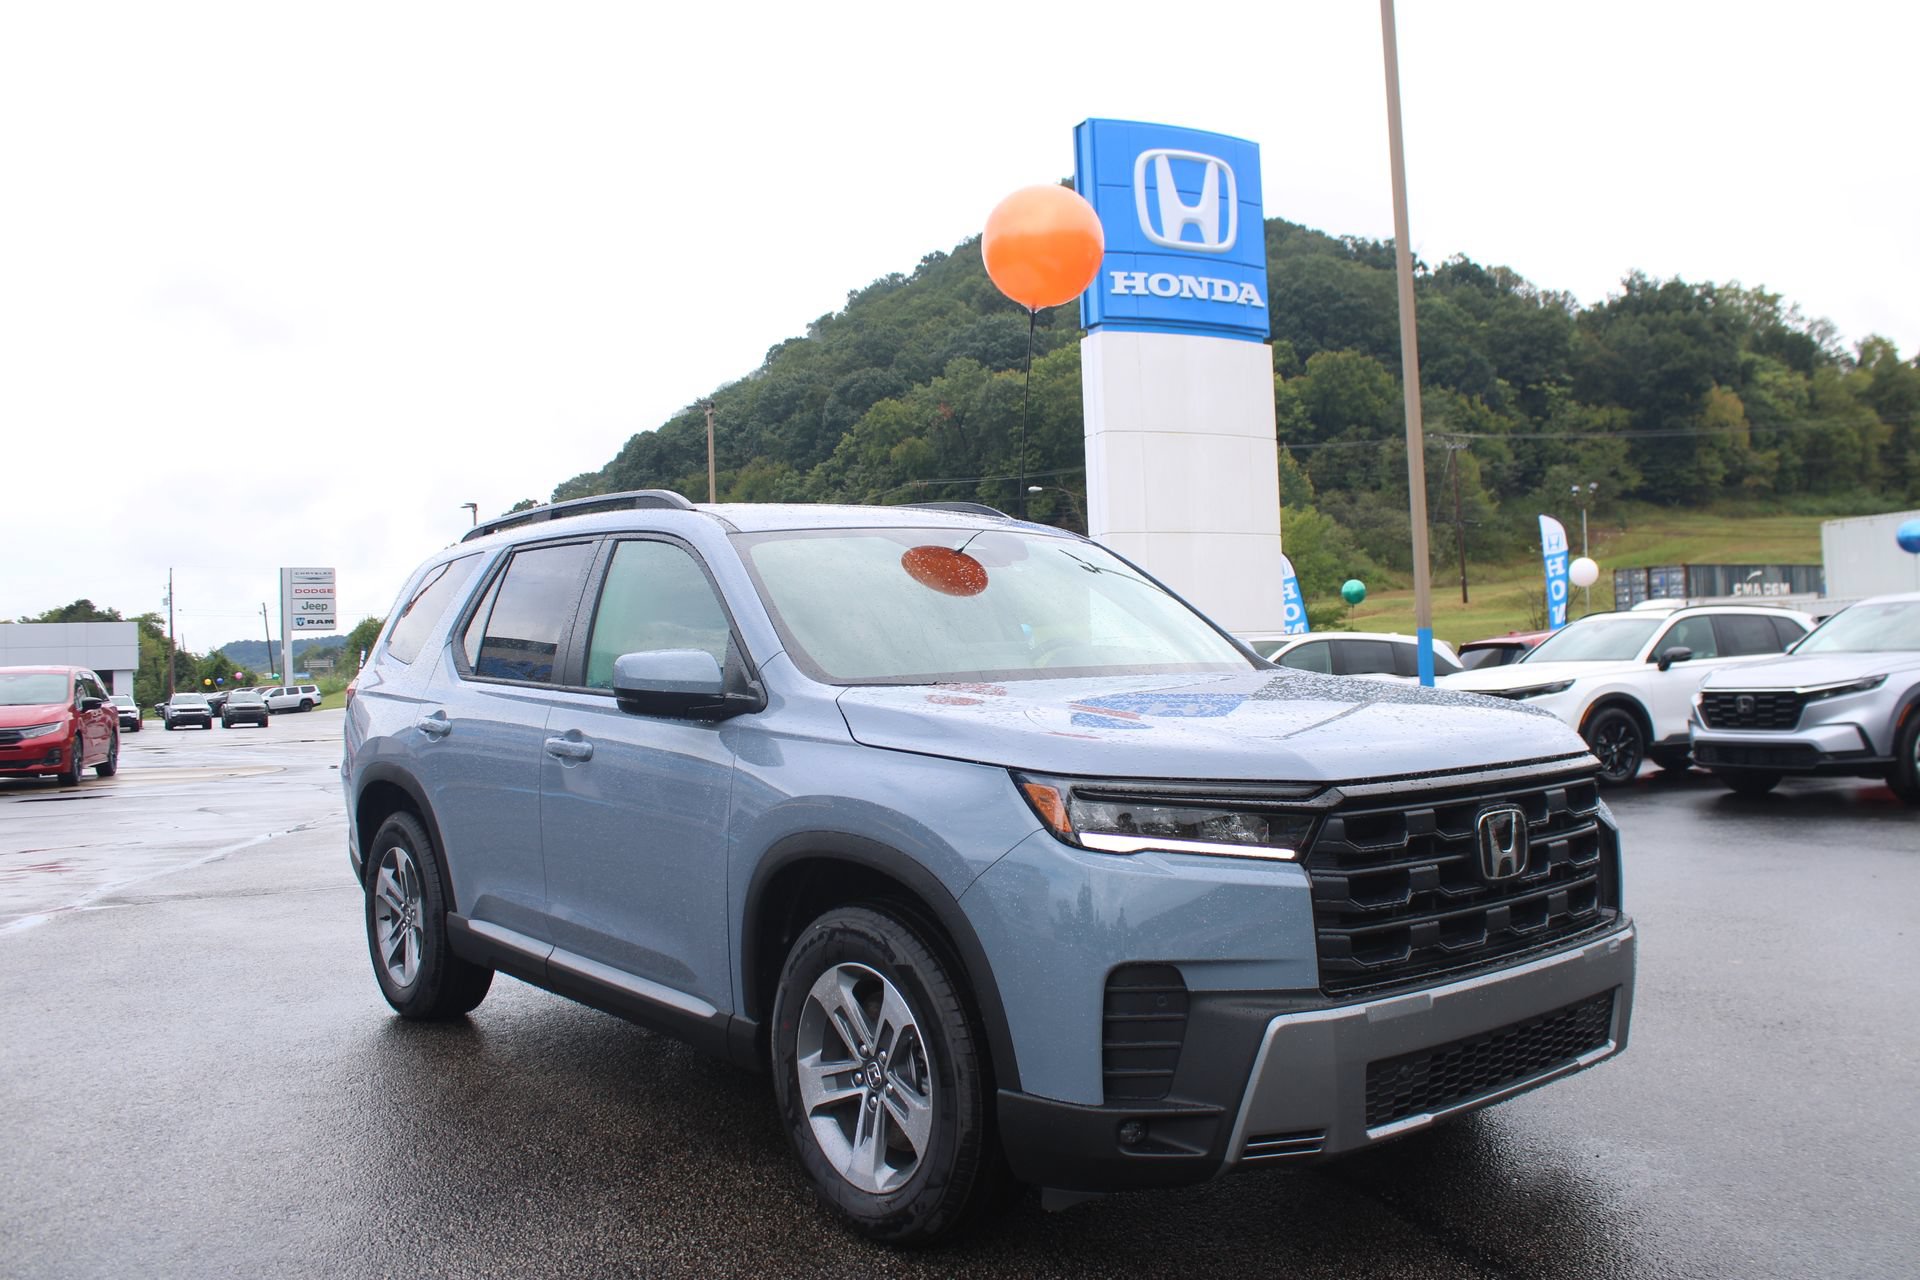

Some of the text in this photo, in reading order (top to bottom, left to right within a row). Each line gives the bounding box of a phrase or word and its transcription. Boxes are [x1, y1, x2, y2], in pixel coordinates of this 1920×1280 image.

[1109, 270, 1266, 308] HONDA
[1733, 582, 1791, 596] CMA CGM
[301, 600, 328, 612] Jeep
